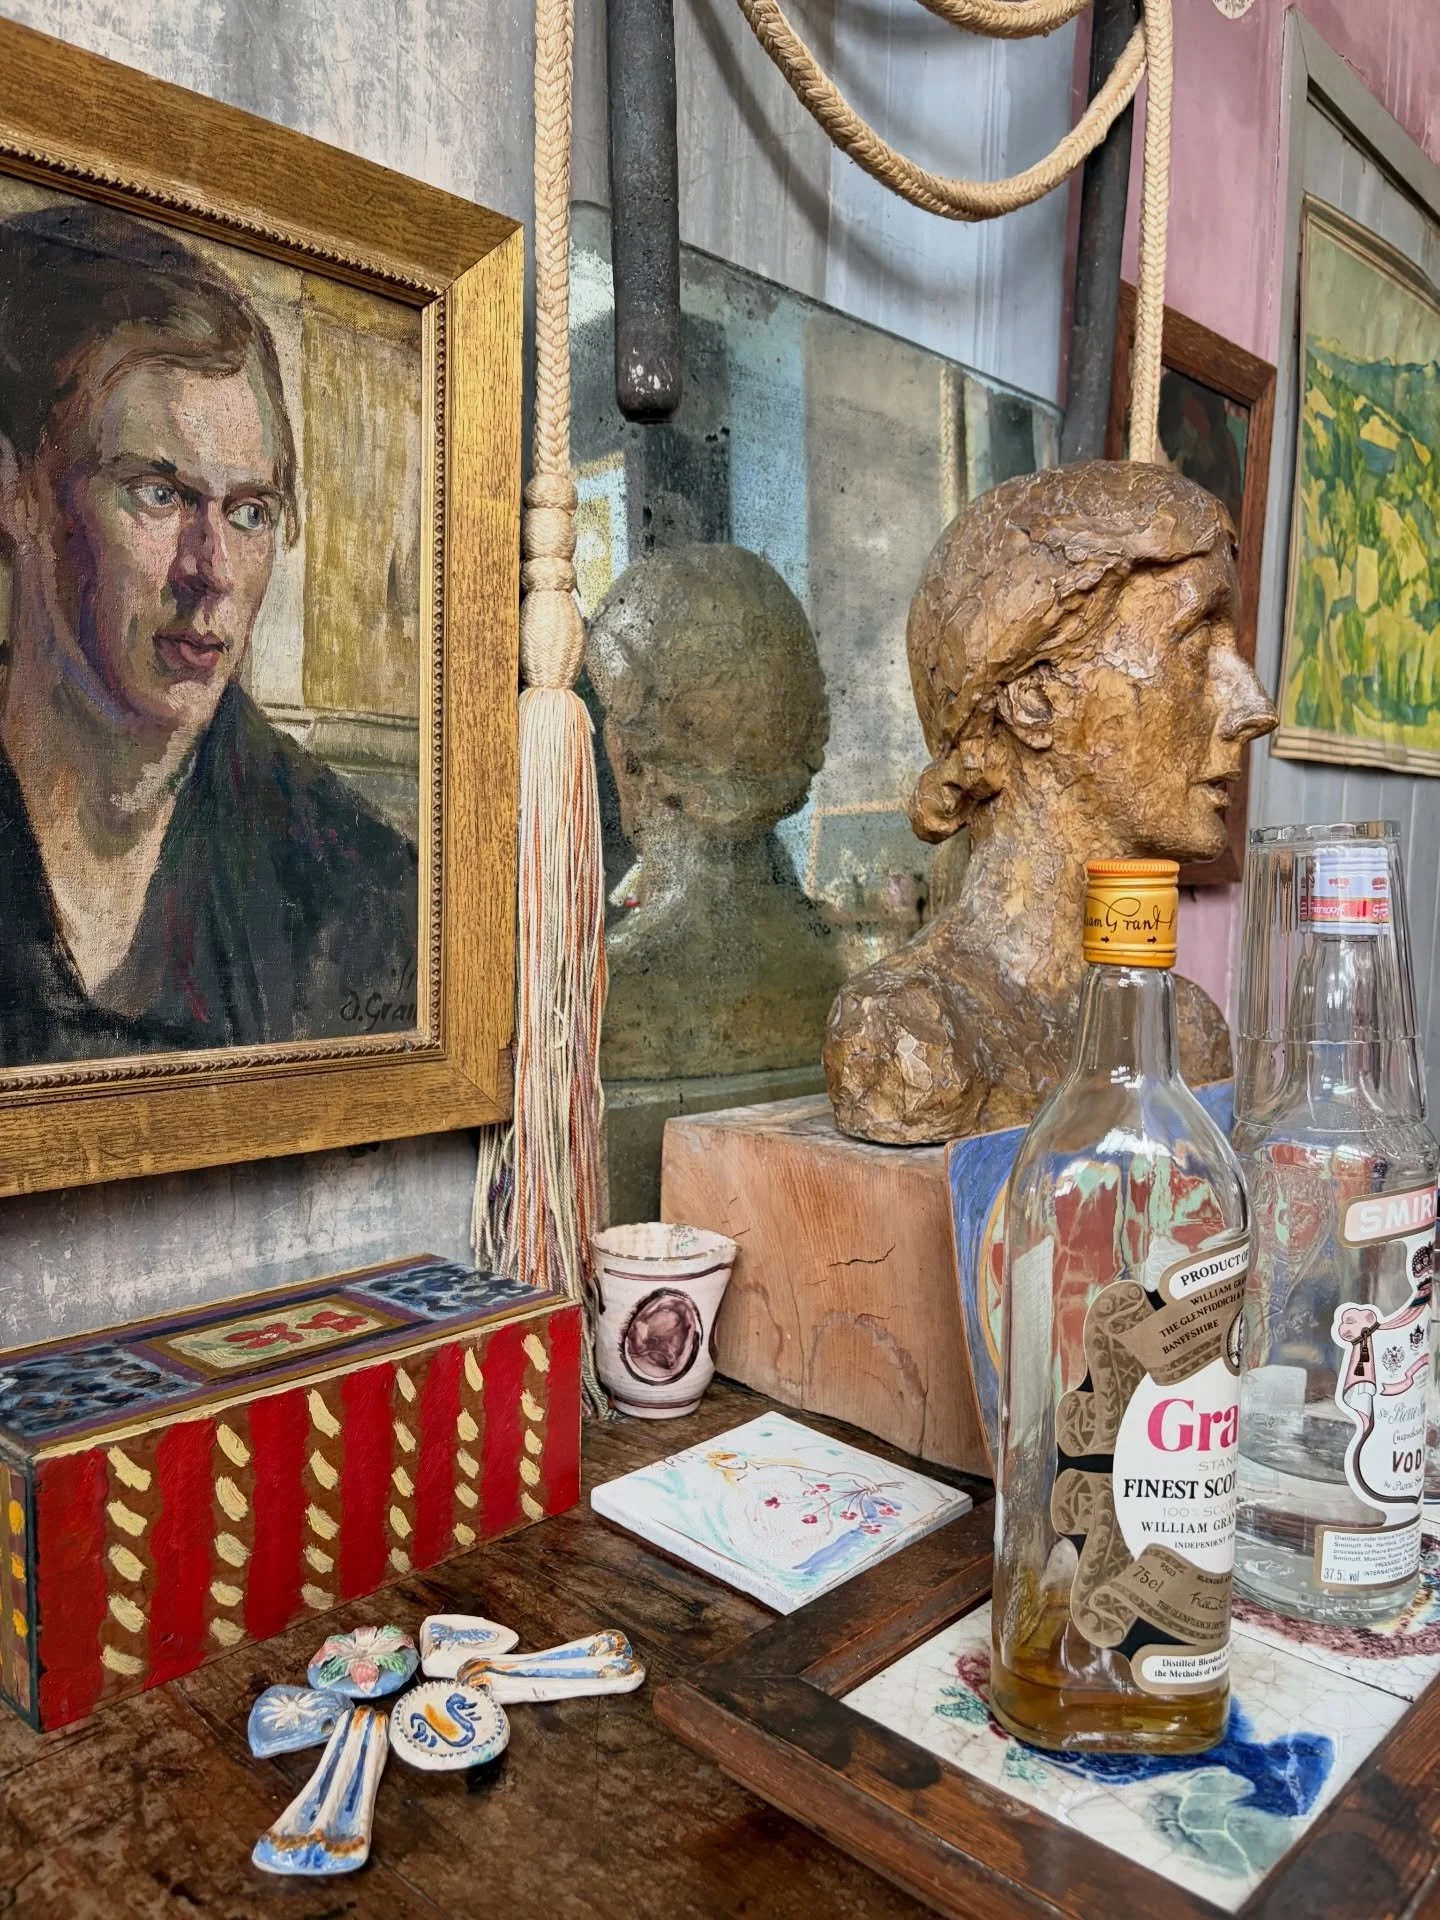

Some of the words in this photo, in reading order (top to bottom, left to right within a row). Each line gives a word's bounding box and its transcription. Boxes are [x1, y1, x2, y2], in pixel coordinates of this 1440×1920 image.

[1180, 1253, 1241, 1287] PRODUCT
[1190, 1283, 1232, 1306] WILLIAM
[1159, 1321, 1181, 1338] THE
[1180, 1293, 1236, 1326] GLENFIDDICH
[1162, 1319, 1220, 1355] BANFFSHIRE
[1123, 1478, 1199, 1500] FINEST
[1141, 1521, 1208, 1534] WILLIAM
[1174, 1535, 1226, 1550] INDEPENDENT
[1132, 1565, 1165, 1593] 75cl
[1154, 1668, 1167, 1677] the
[1169, 1668, 1203, 1679] Methods
[1203, 1667, 1211, 1676] of
[1162, 1658, 1196, 1667] Distilled
